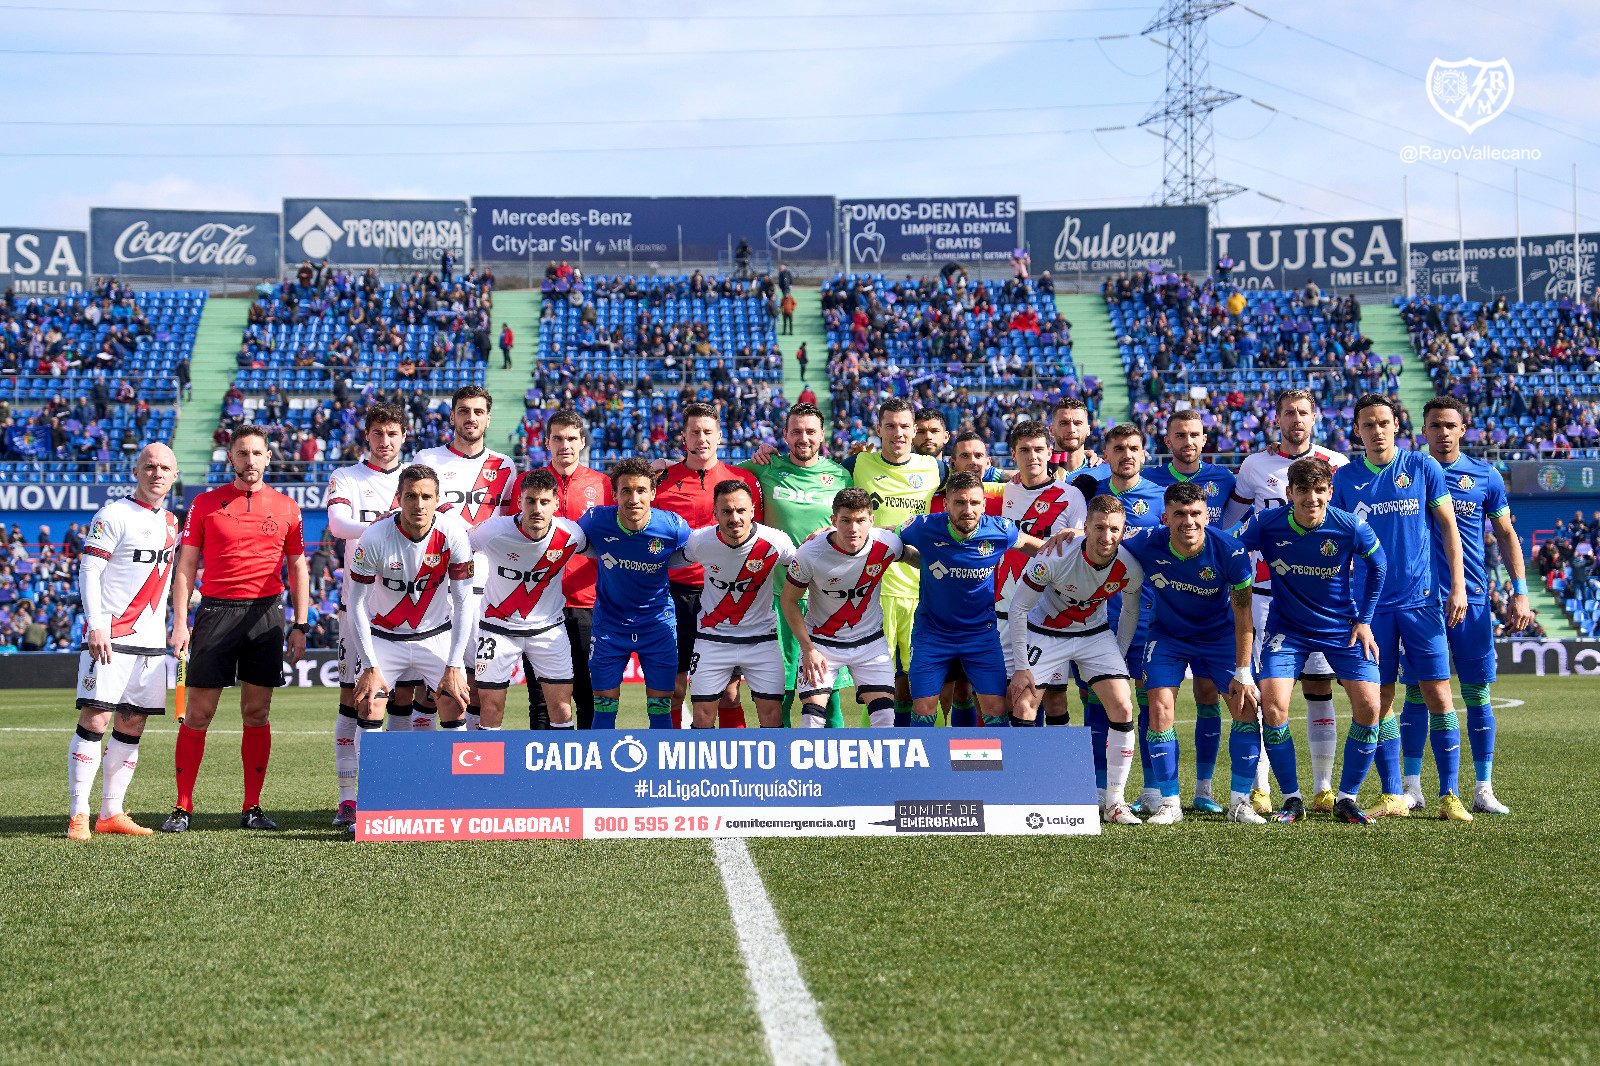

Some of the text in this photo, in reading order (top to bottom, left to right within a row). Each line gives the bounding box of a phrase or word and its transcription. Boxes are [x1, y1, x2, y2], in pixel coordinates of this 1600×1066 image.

[492, 208, 632, 226] Mercedes-Benz
[343, 219, 463, 248] TECNOCASA
[901, 222, 1013, 235] LIMPIEZA DENTAL
[1053, 215, 1177, 261] Bulevar
[114, 220, 256, 265] Coca-Cola
[492, 235, 557, 255] Citycar
[560, 235, 591, 252] Sur
[935, 237, 982, 250] GRATIS
[1216, 225, 1397, 272] LUJISA
[1431, 247, 1496, 262] estamos
[1498, 245, 1526, 259] con
[1528, 242, 1542, 257] la
[1091, 259, 1125, 270] CENTRO
[1330, 270, 1397, 286] IMELCO
[477, 637, 496, 660] 23
[525, 738, 931, 771] CADA MINUTO CUENTA
[635, 778, 822, 800] #LaLigaConTurquíaSiria
[899, 803, 977, 816] COMITÉ DE
[365, 815, 571, 835] ¡SÚMATE Y COLABORA!
[594, 817, 628, 831] 900
[634, 817, 668, 831] 595
[674, 816, 709, 831] 216
[725, 818, 856, 831] comiteemergencia.org
[900, 816, 979, 828] EMERGENCIA
[1046, 815, 1085, 827] LaLiga
